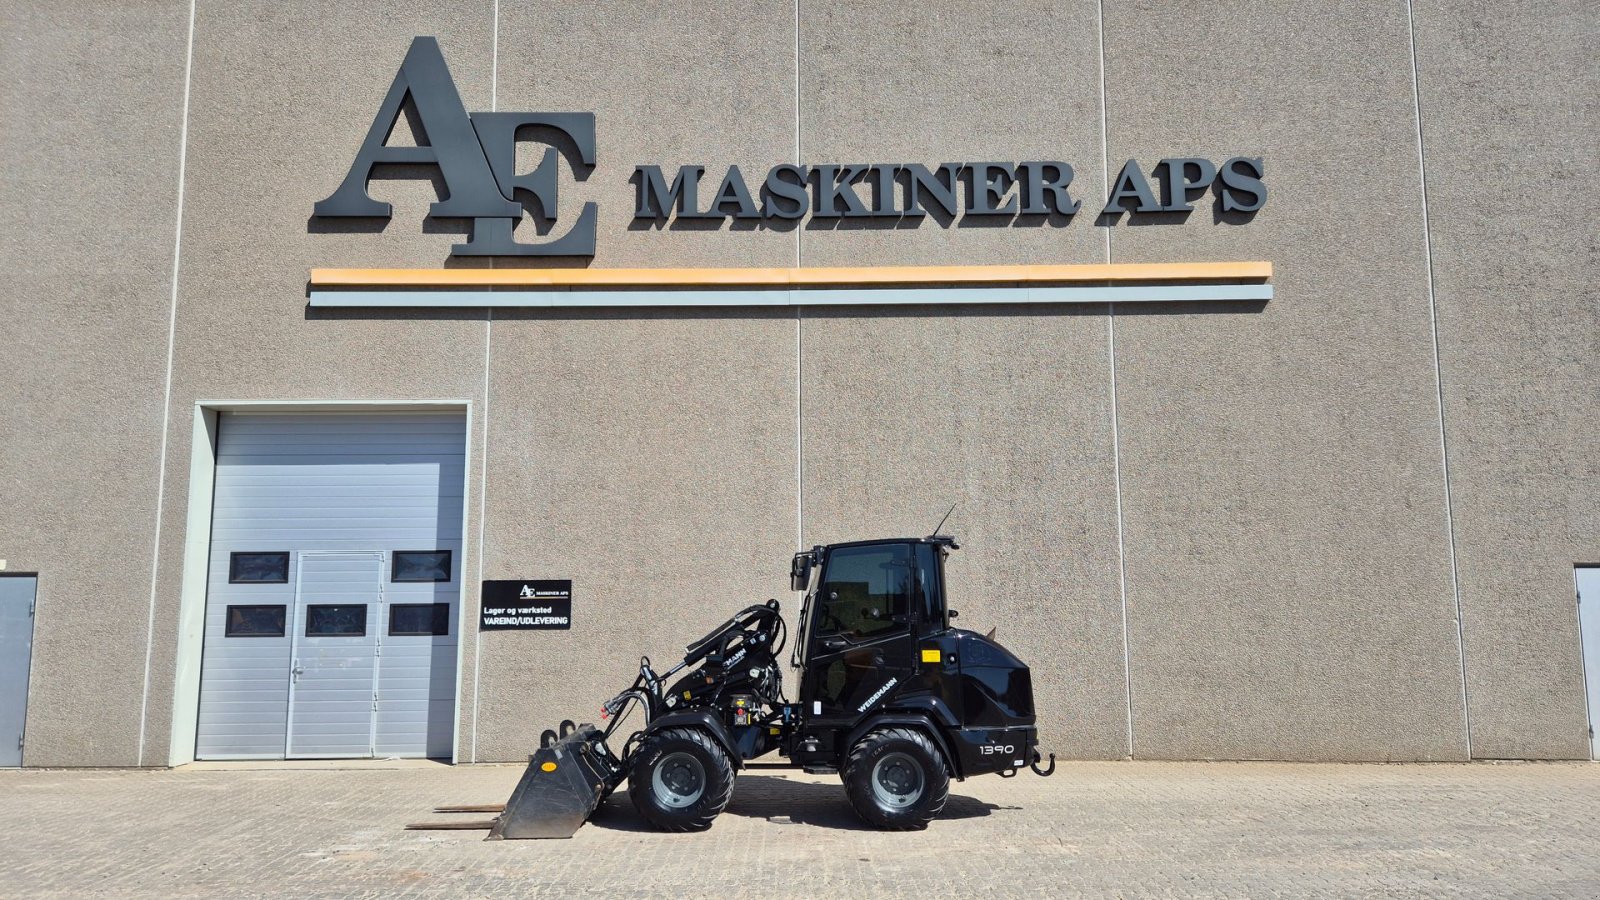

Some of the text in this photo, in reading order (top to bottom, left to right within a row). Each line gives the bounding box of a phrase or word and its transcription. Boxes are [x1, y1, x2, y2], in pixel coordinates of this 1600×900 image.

[313, 36, 1268, 257] AE MASKINER APS
[484, 607, 505, 615] Lager
[484, 617, 568, 625] VAREIND/UDLEVERING
[857, 677, 898, 712] WEIDEMANN
[980, 745, 1014, 755] 1390
